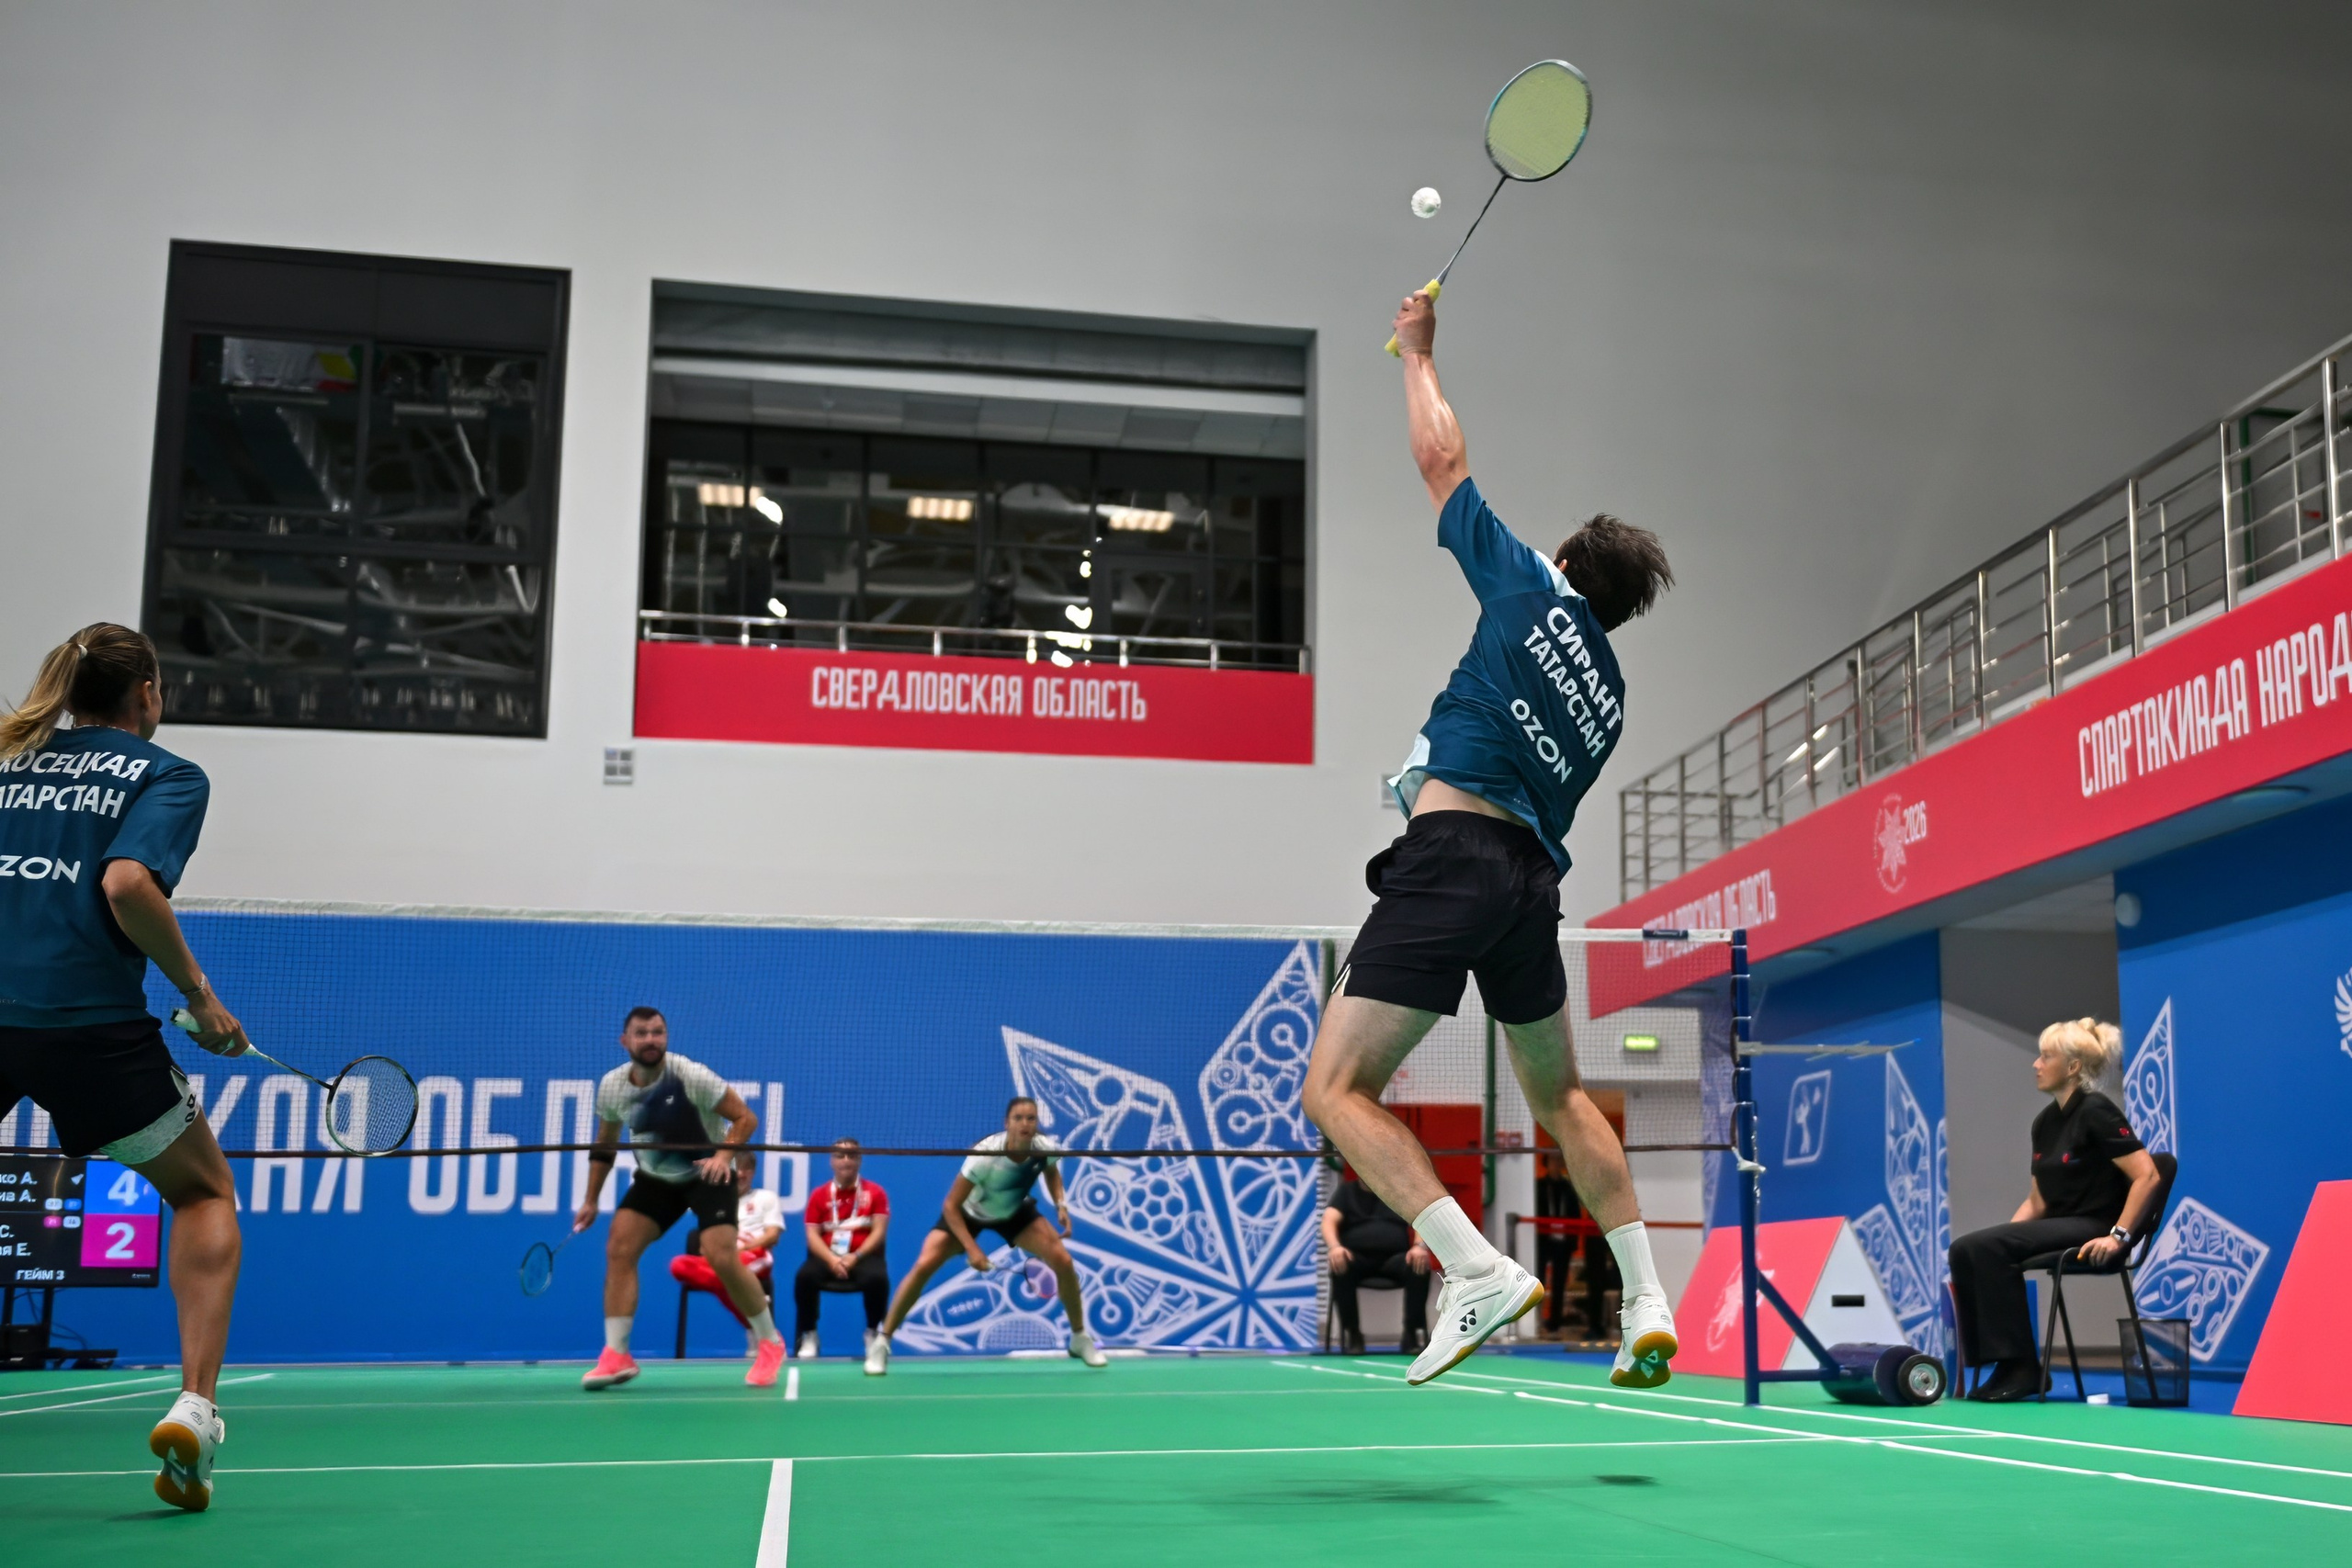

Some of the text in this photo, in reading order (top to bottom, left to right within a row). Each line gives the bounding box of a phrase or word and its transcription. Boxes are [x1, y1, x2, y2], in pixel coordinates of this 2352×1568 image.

[811, 667, 1147, 721] СВЕРДЛОВСКАЯ ОБЛАСТЬ
[1523, 625, 1606, 758] ТАТАРСТАН
[1546, 606, 1623, 730] СИРАНТ
[2078, 610, 2352, 798] СПАРТАКИАДА НАРОД
[1510, 698, 1573, 784] OZON
[1903, 800, 1927, 845] 2026
[107, 1169, 140, 1207] 4
[105, 1222, 135, 1259] 2
[16, 1267, 65, 1280] ГЕЙМ 3
